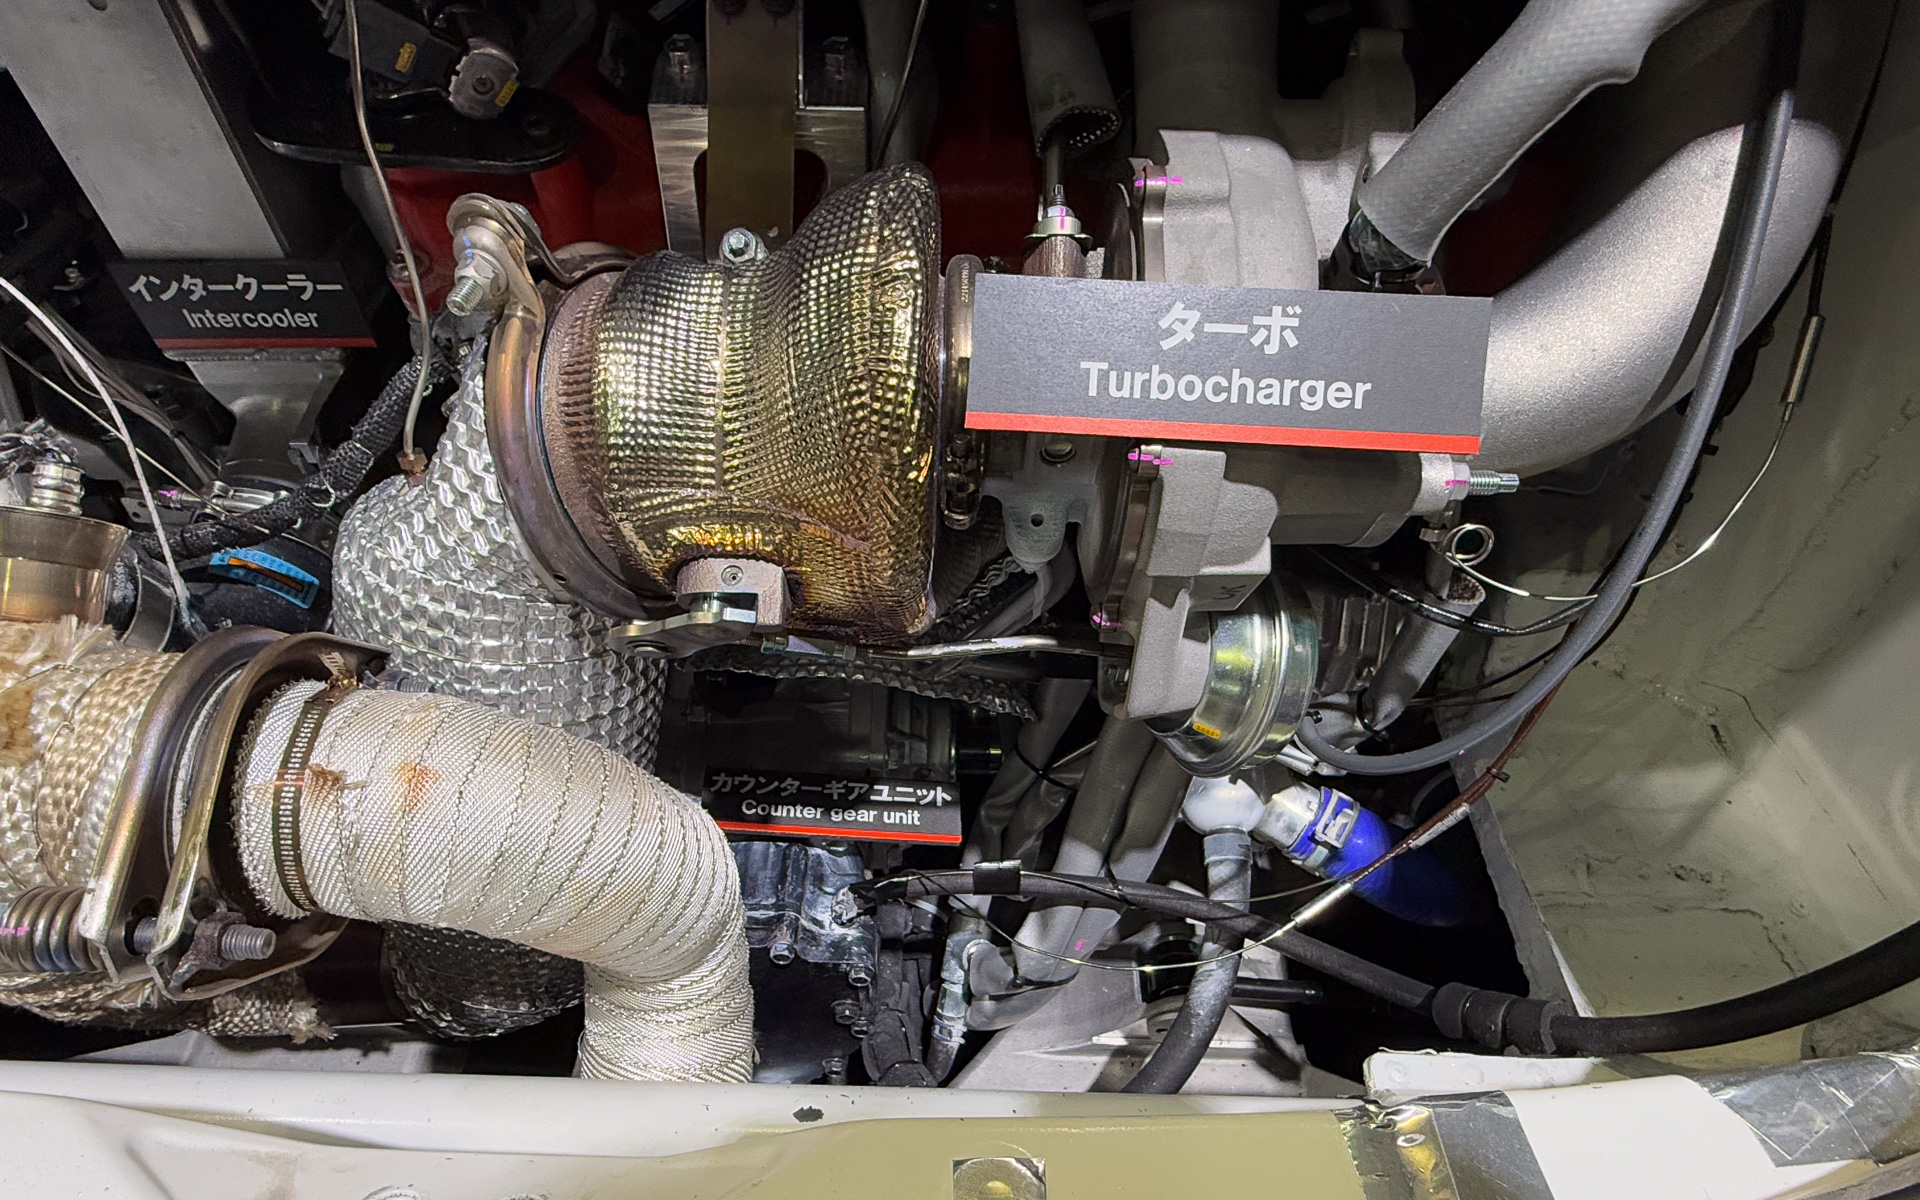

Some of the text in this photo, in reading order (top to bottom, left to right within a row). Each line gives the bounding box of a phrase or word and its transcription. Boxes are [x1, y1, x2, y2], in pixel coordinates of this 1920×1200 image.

[128, 273, 344, 302] インタークーラー
[182, 308, 319, 328] Intercooler
[1158, 302, 1303, 355] ターボ
[1080, 361, 1372, 412] Turbocharger
[709, 772, 953, 807] カウンターギアユニット
[741, 799, 921, 825] Counter gear unit
